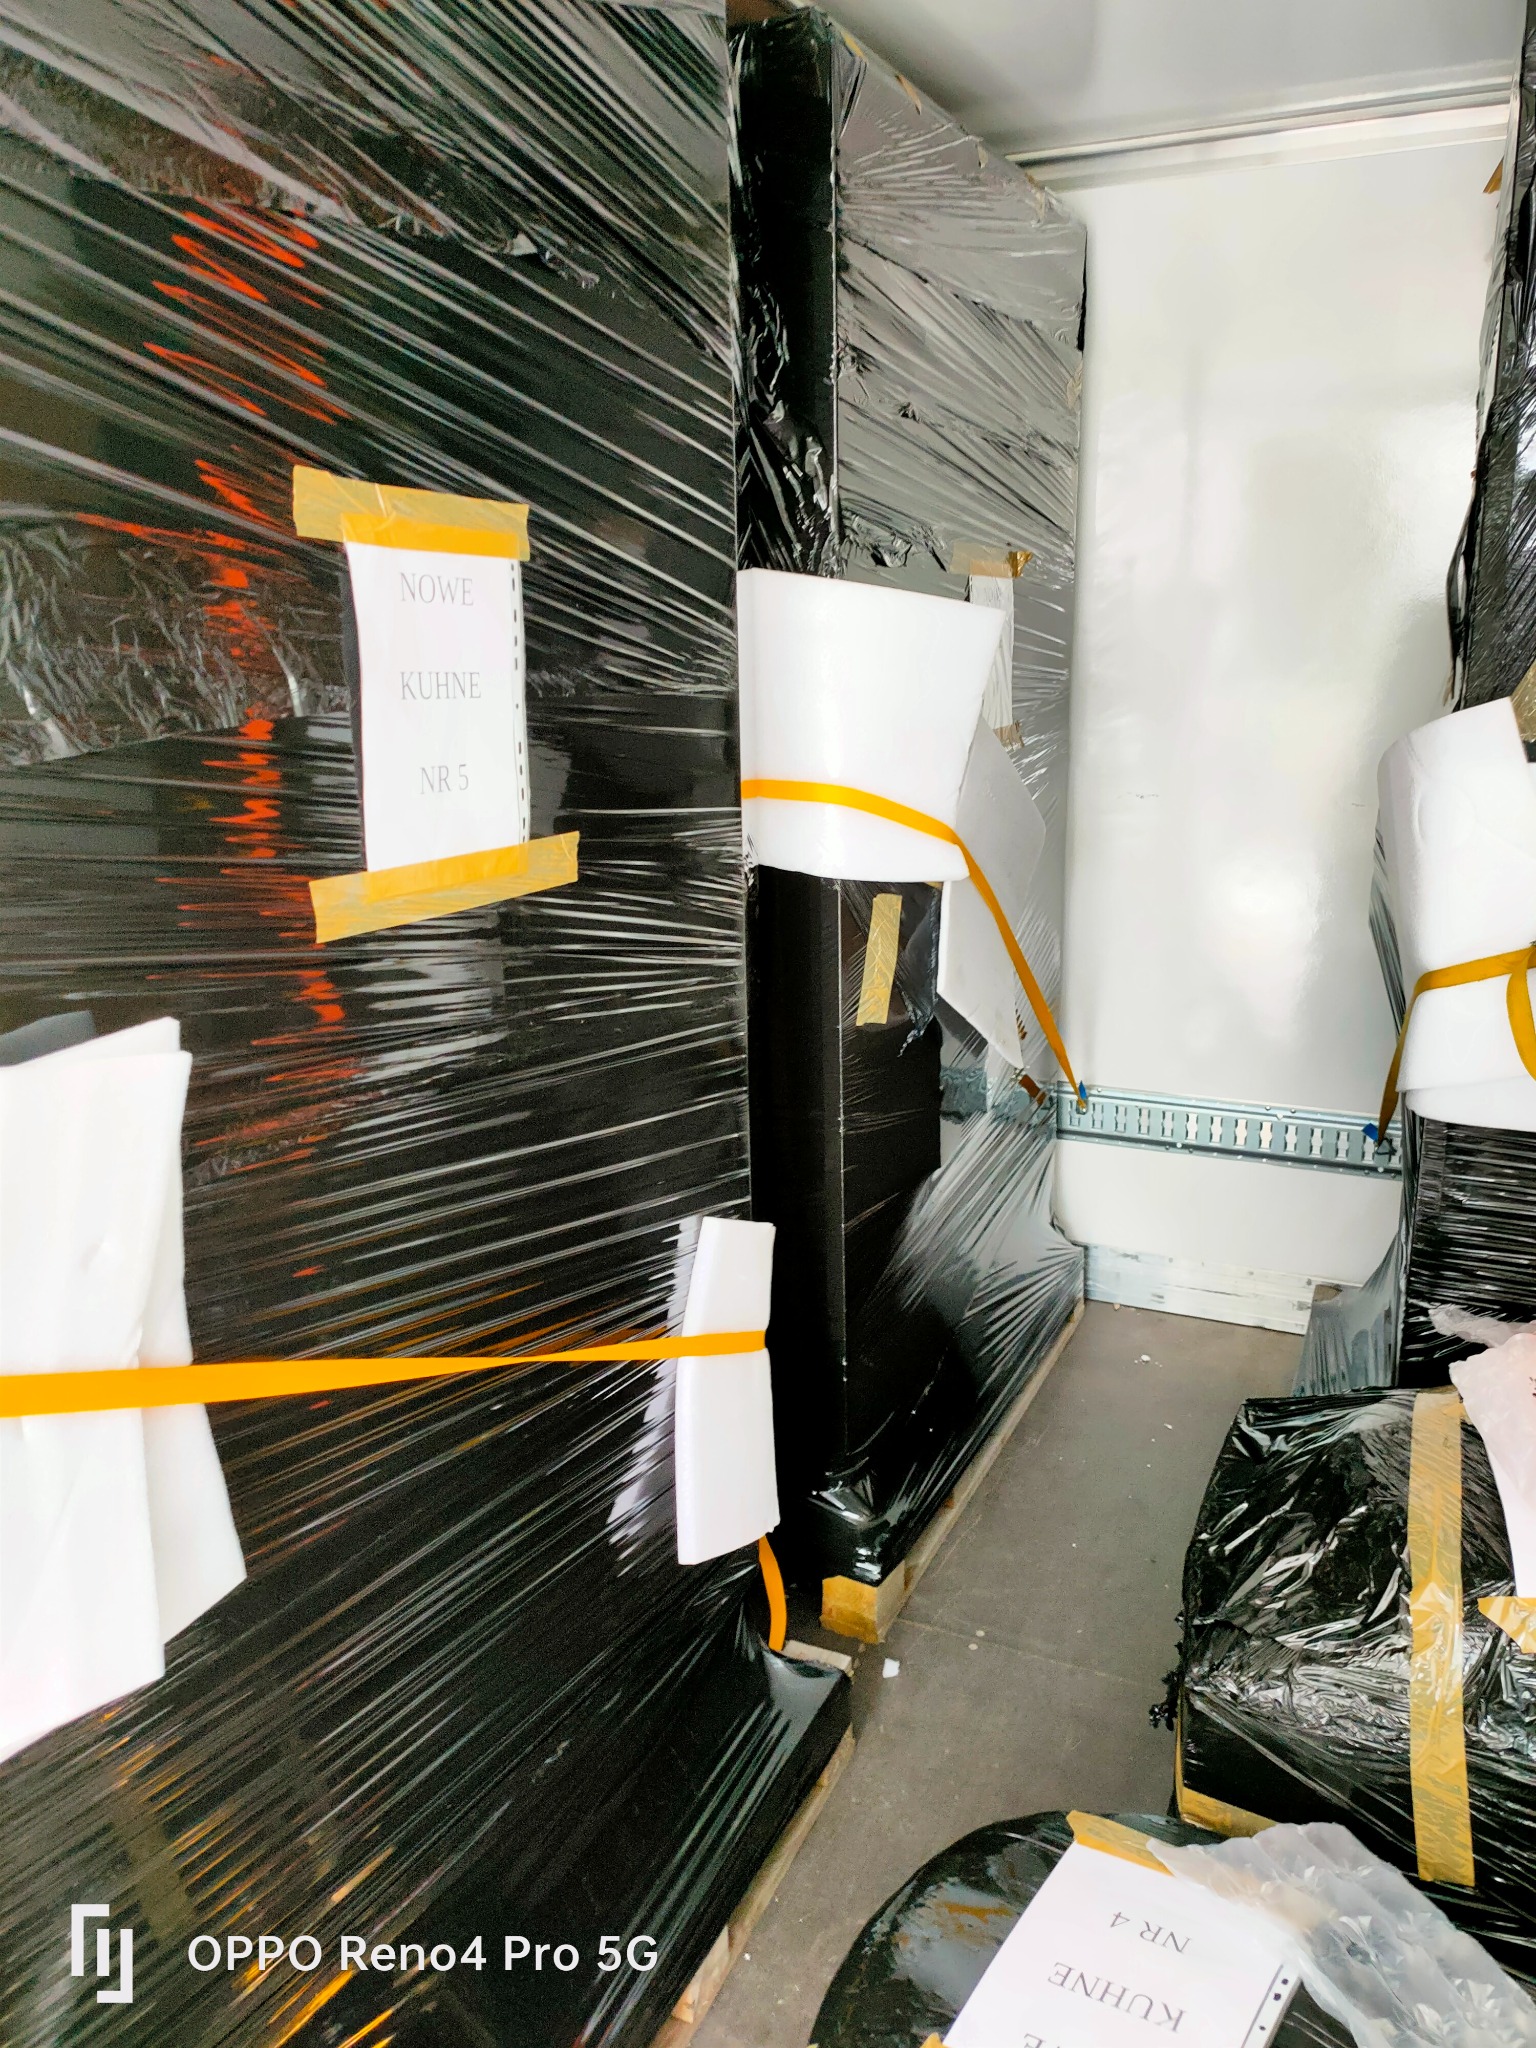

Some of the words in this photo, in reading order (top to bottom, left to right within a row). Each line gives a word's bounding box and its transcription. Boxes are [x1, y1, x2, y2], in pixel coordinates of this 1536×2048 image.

[400, 571, 474, 606] NOWE
[400, 671, 482, 700] KUHNE
[420, 765, 452, 794] NR
[458, 763, 469, 791] 5
[1109, 1911, 1131, 1928] 4
[1139, 1920, 1191, 1953] NR
[1047, 1962, 1186, 2033] KUHNE
